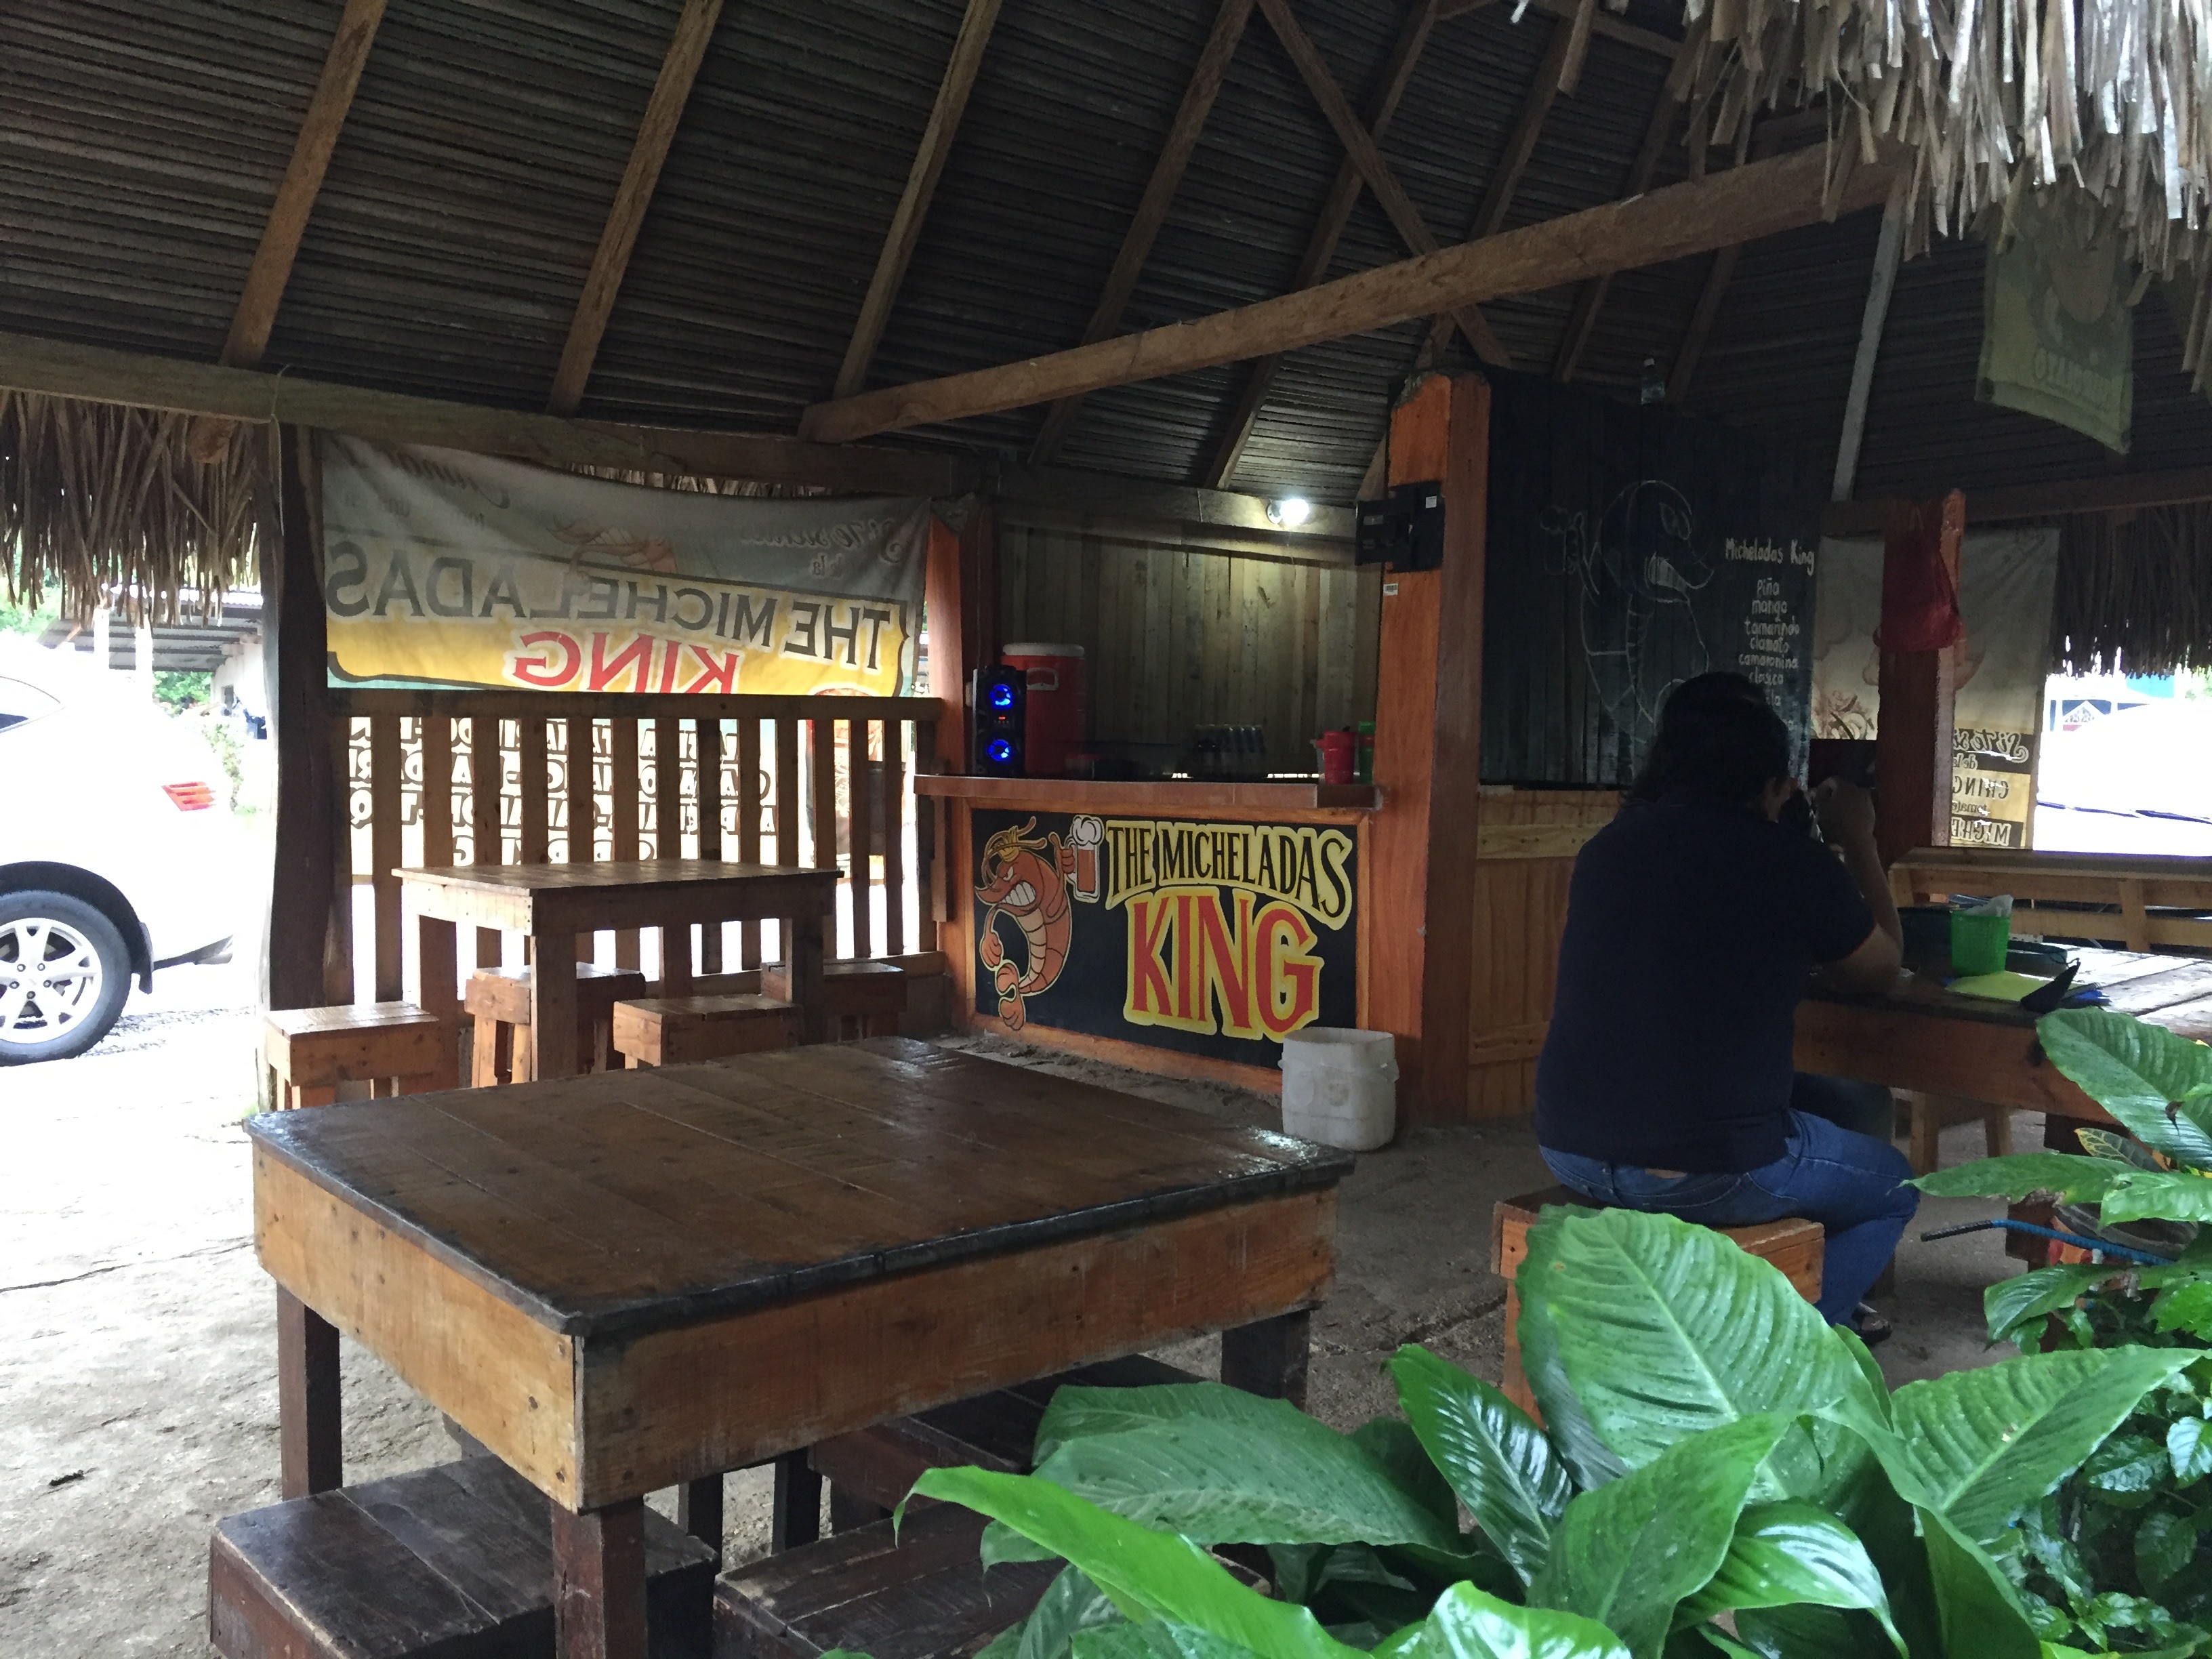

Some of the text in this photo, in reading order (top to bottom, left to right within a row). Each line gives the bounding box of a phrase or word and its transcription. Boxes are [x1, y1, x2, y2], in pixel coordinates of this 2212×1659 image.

[1790, 538, 1815, 577] King
[1107, 826, 1346, 918] THE MICHELADAS
[1132, 895, 1315, 1032] KING
